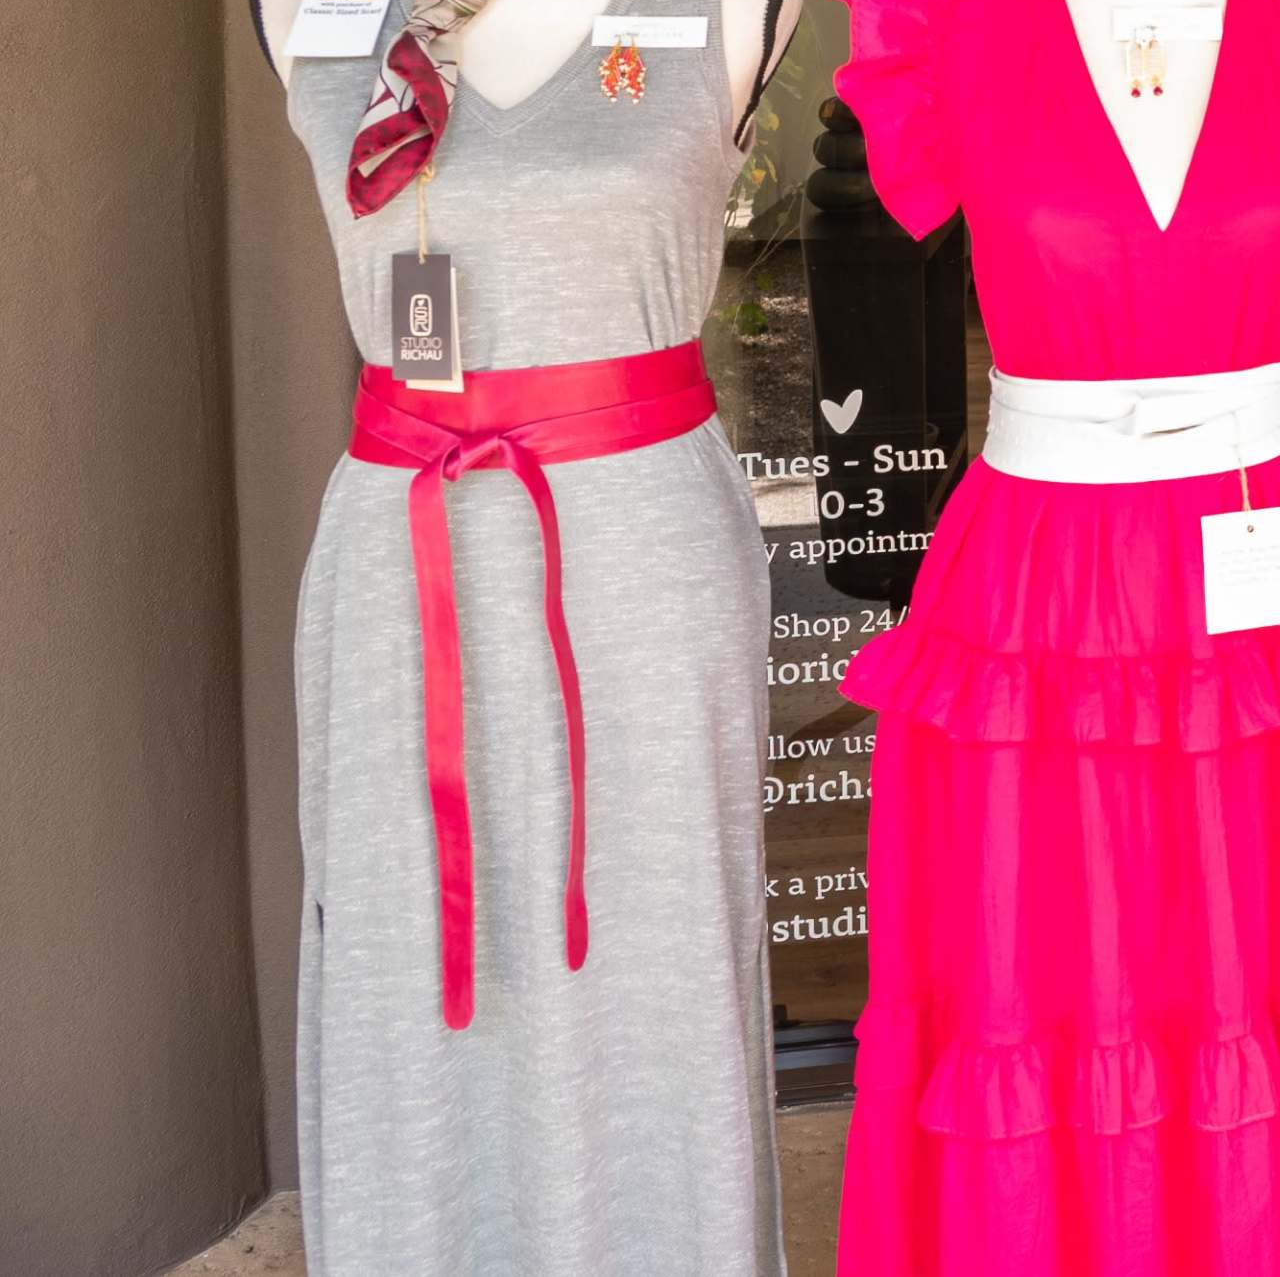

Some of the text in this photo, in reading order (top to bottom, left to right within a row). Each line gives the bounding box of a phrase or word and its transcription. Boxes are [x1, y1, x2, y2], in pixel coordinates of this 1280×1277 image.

[400, 336, 443, 350] STUDIO
[400, 349, 443, 361] RICHAU
[737, 452, 830, 481] Tues
[873, 444, 948, 474] Sun
[773, 605, 911, 642] Shop 24/
[763, 770, 873, 813] @rich
[788, 877, 806, 896] a
[766, 906, 869, 943] studi
